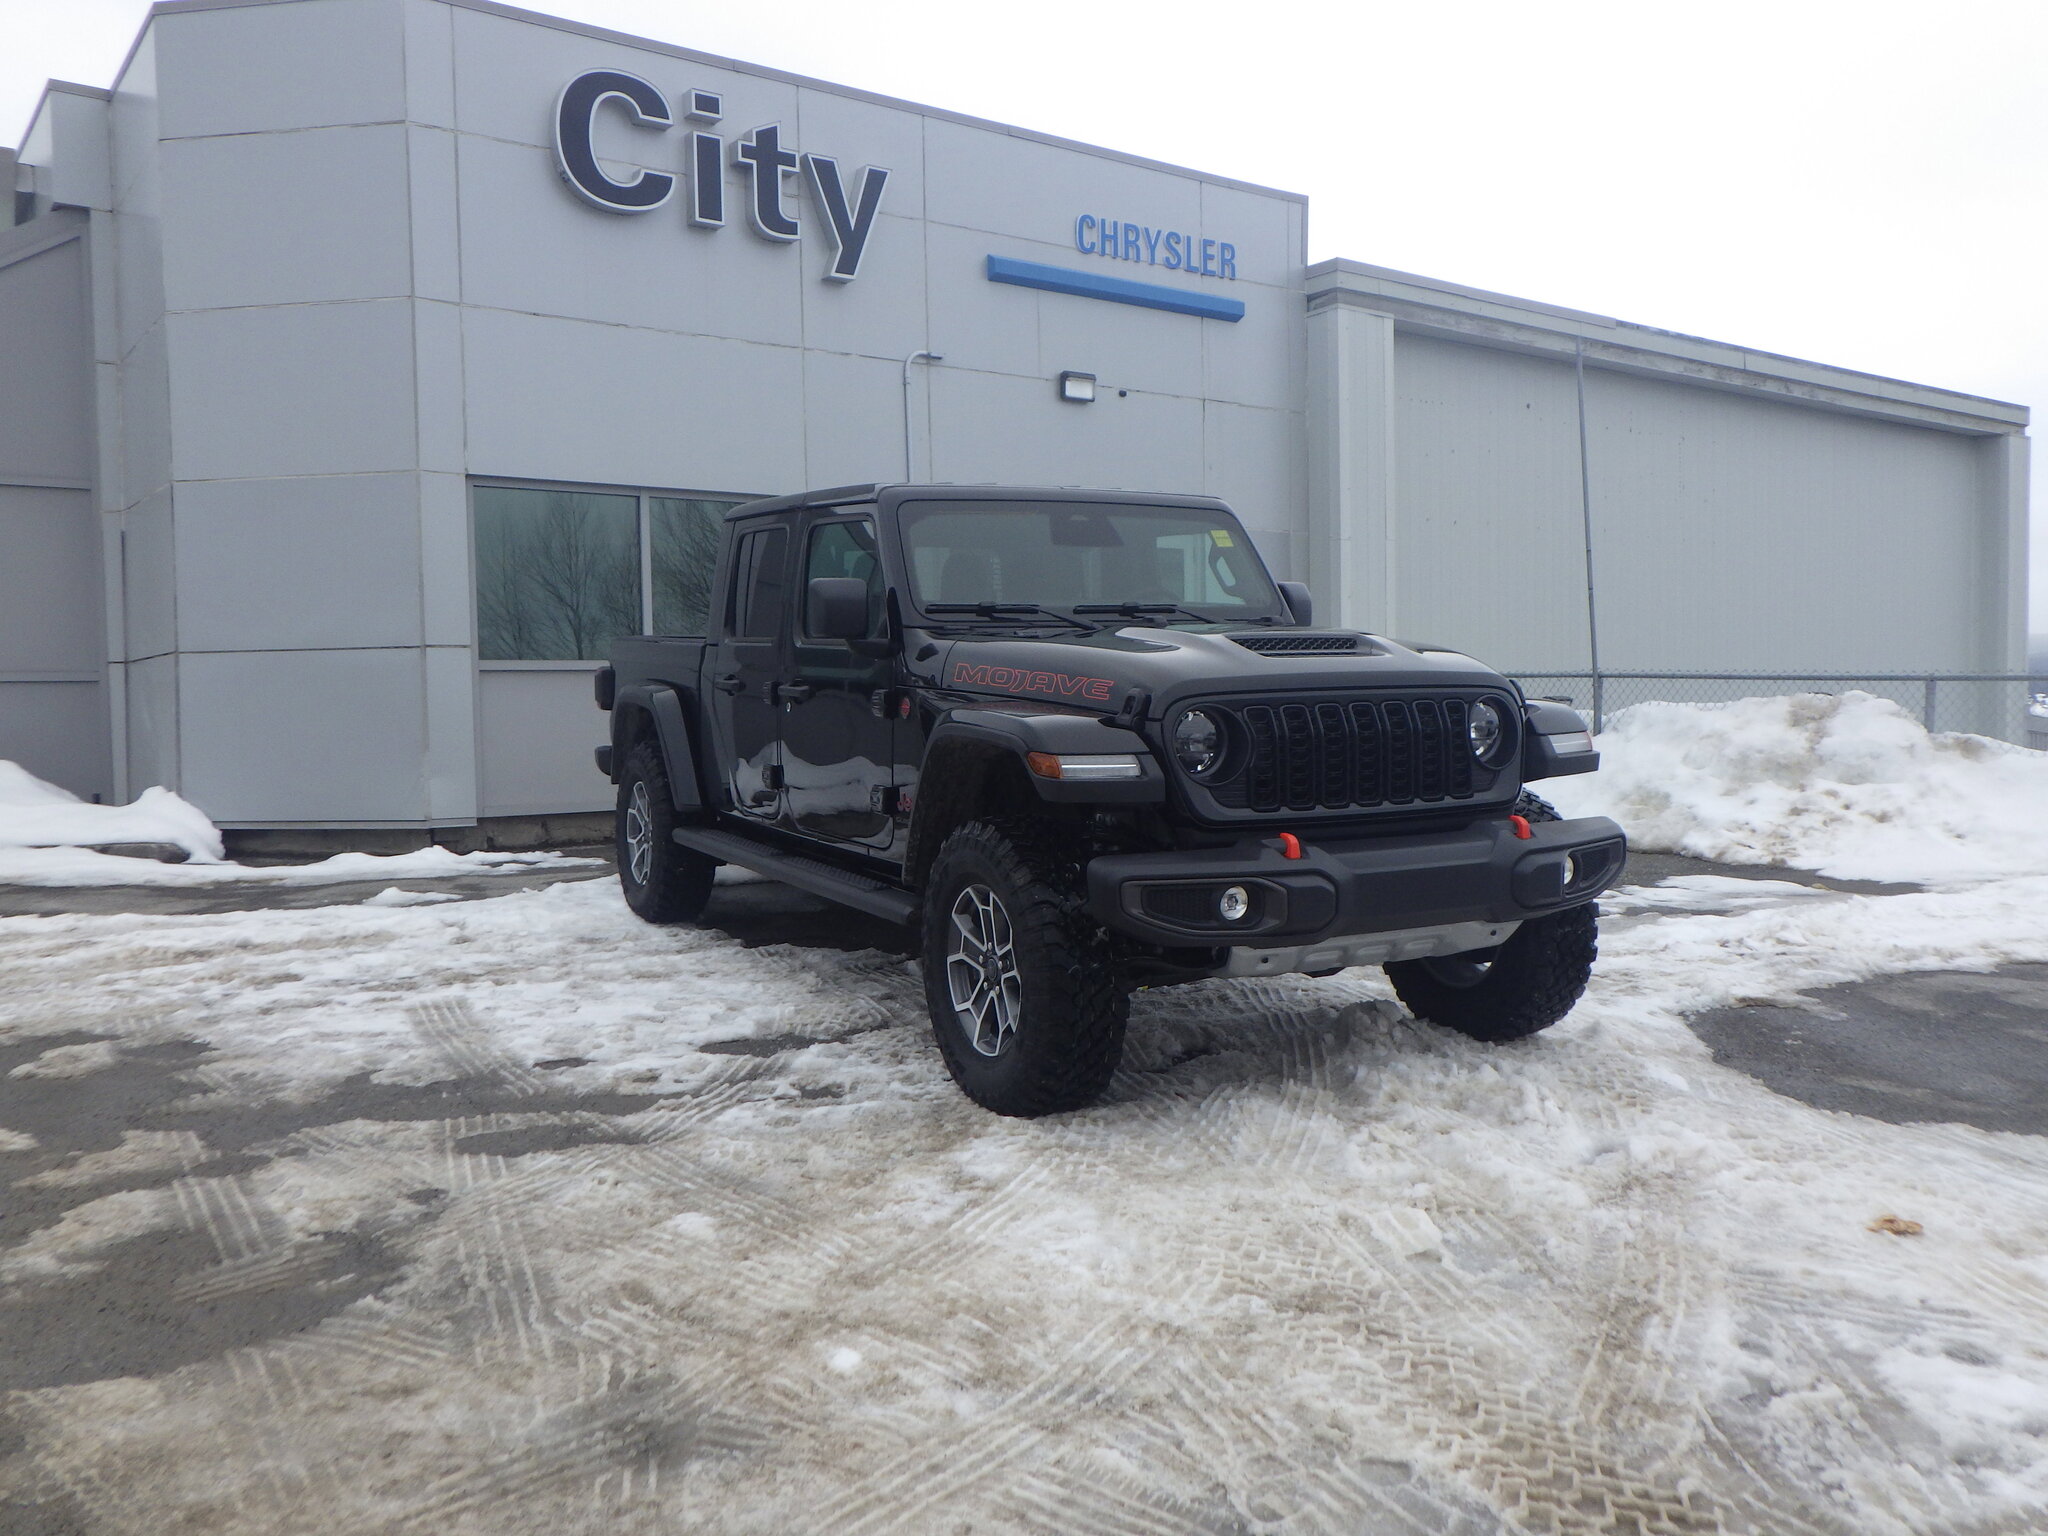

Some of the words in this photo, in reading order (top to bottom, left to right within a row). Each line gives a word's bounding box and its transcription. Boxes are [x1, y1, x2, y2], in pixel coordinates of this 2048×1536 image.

[551, 67, 893, 284] City
[1076, 213, 1237, 281] CHRYSLER
[954, 663, 1114, 700] MOJAVE
